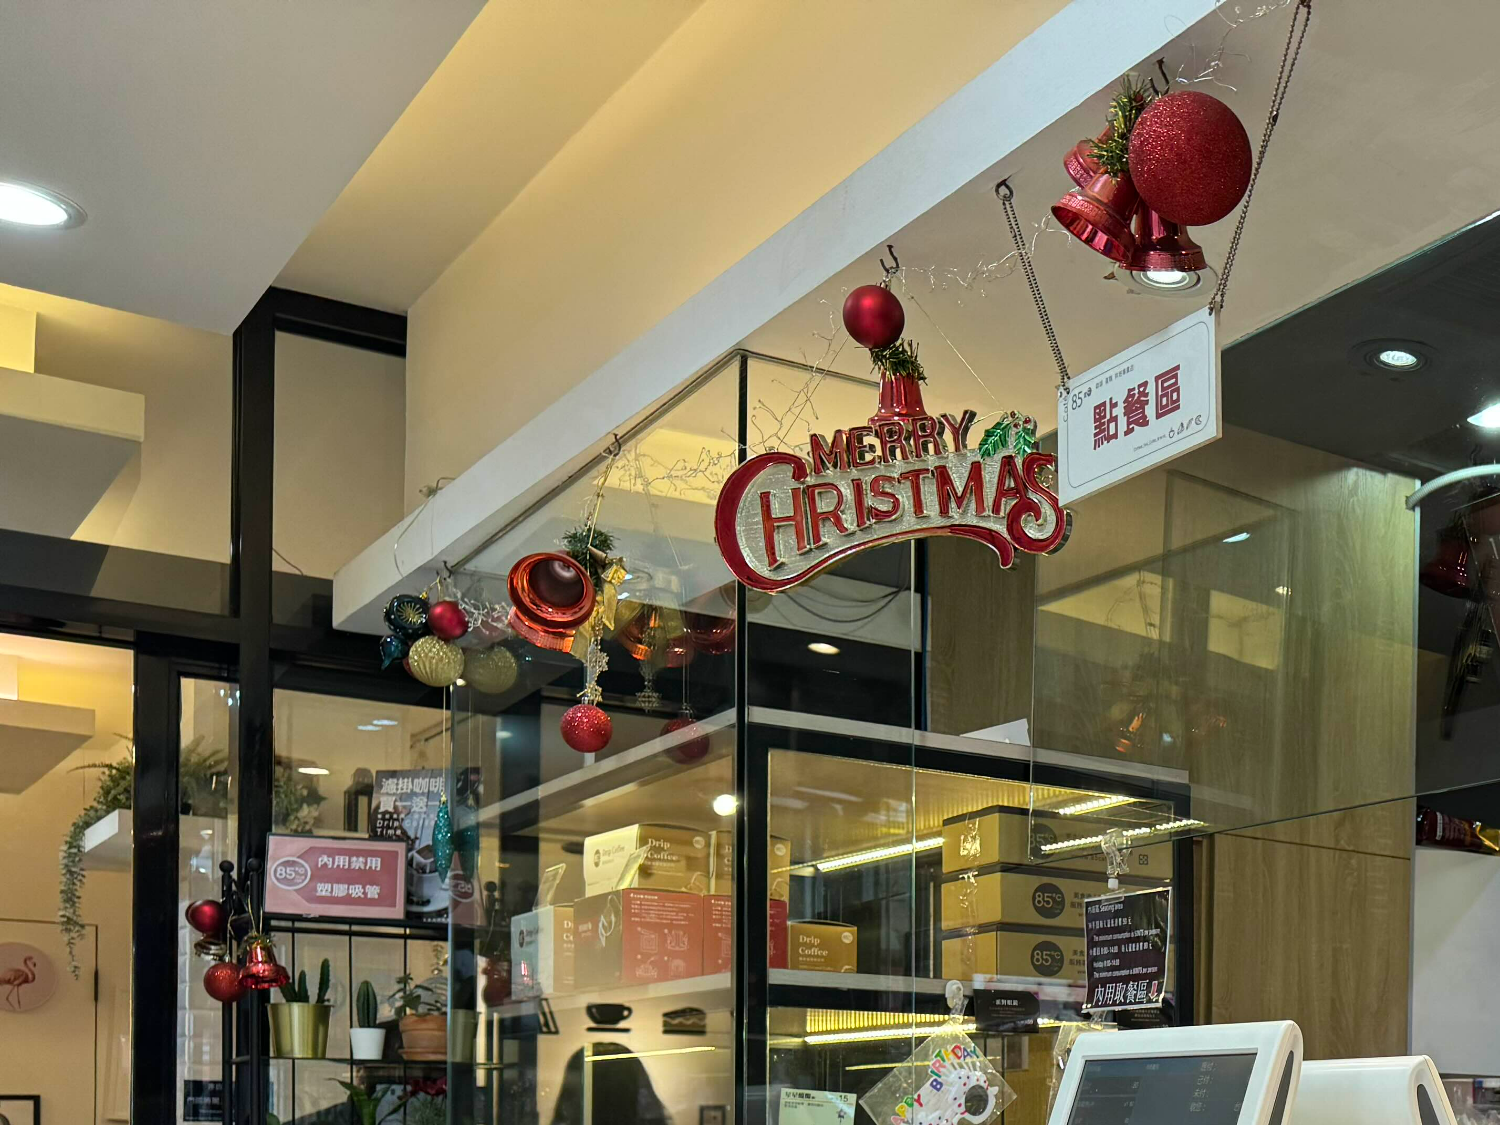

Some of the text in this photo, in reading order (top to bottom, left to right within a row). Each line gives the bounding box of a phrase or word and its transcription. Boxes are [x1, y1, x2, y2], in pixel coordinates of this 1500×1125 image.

[1093, 363, 1181, 451] 點餐區
[810, 409, 977, 475] MERRY
[714, 452, 1067, 594] CHRISTMAS
[381, 777, 444, 794] 濾掛咖啡
[648, 838, 670, 849] Drip
[317, 855, 381, 871] 內用禁用
[647, 850, 678, 862] Coffee
[316, 883, 381, 899] 塑膠吸管
[799, 935, 821, 946] Drip
[799, 947, 829, 957] Coffee
[1093, 980, 1149, 1006] 內用取餐區
[929, 1044, 980, 1092] BIRTHDAY
